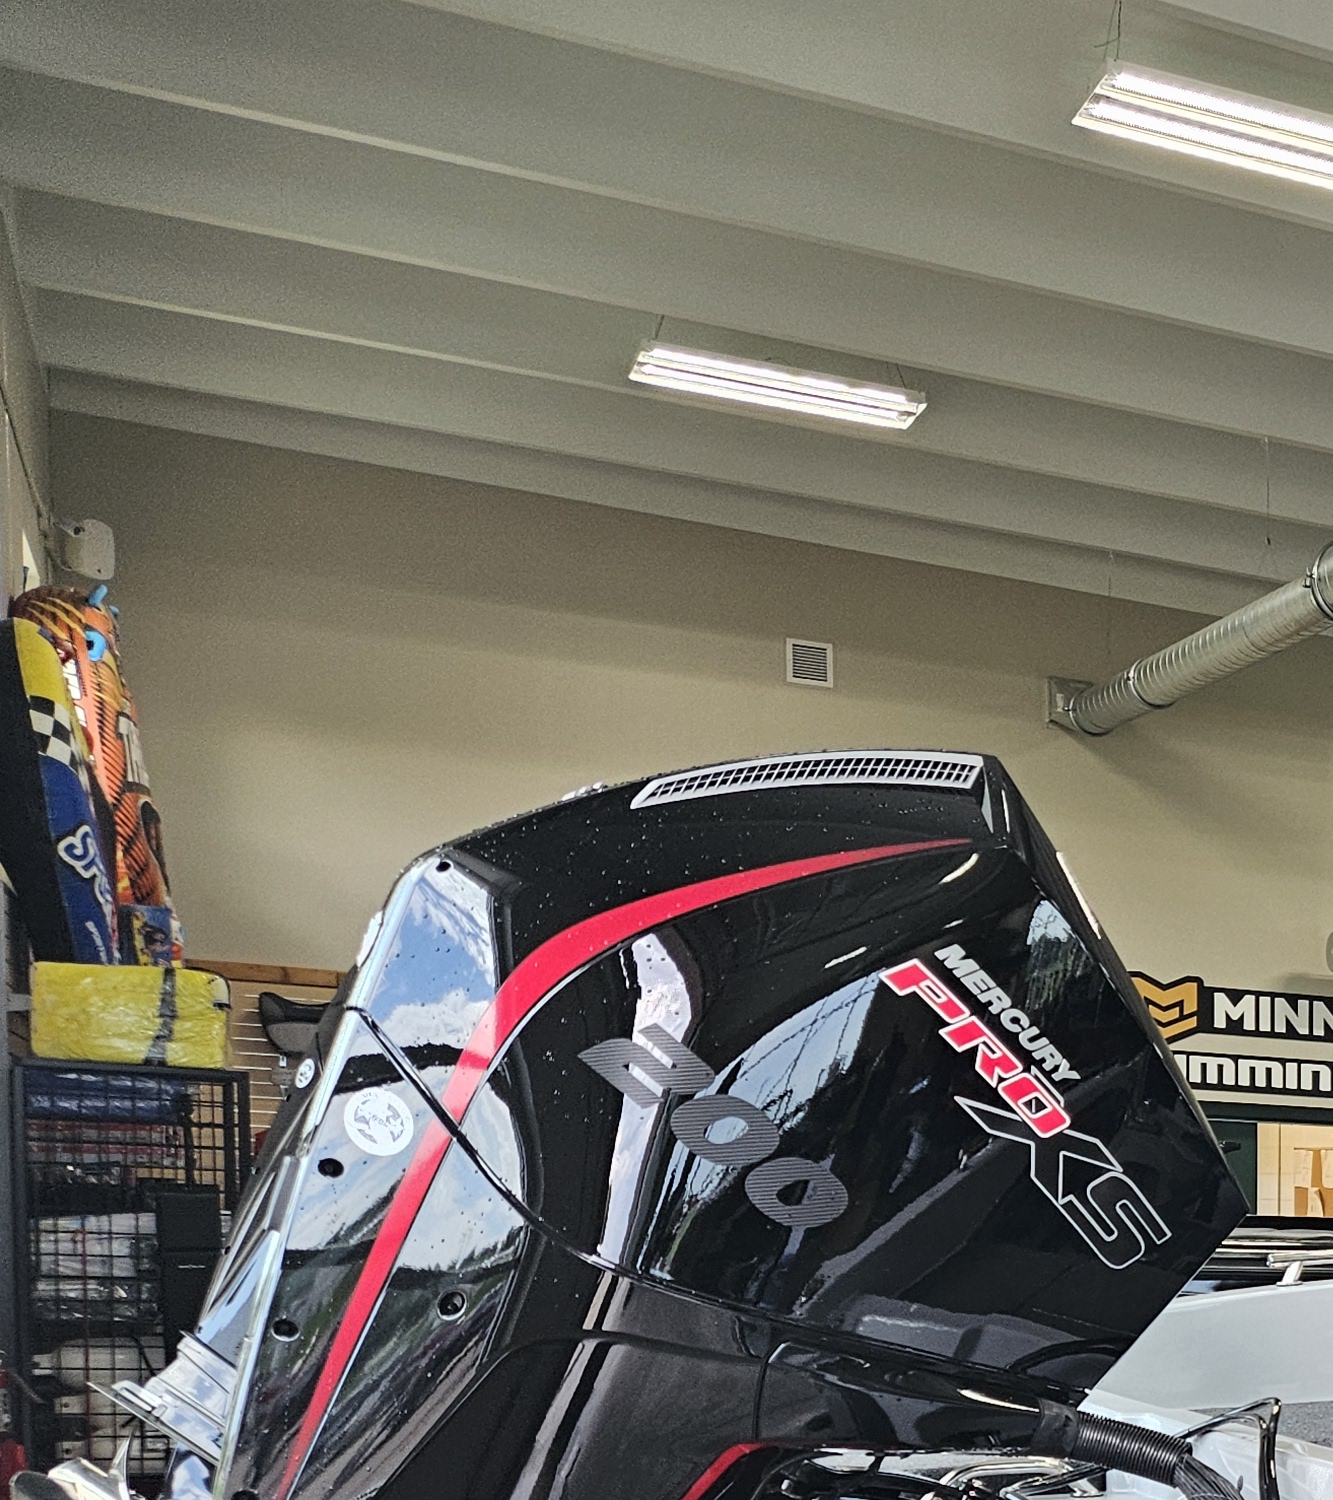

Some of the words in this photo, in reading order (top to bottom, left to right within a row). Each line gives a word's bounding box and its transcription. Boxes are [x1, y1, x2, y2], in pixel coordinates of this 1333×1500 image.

[878, 957, 1071, 1139] PRO
[934, 944, 1081, 1082] MERCURY
[953, 1064, 1172, 1269] XS
